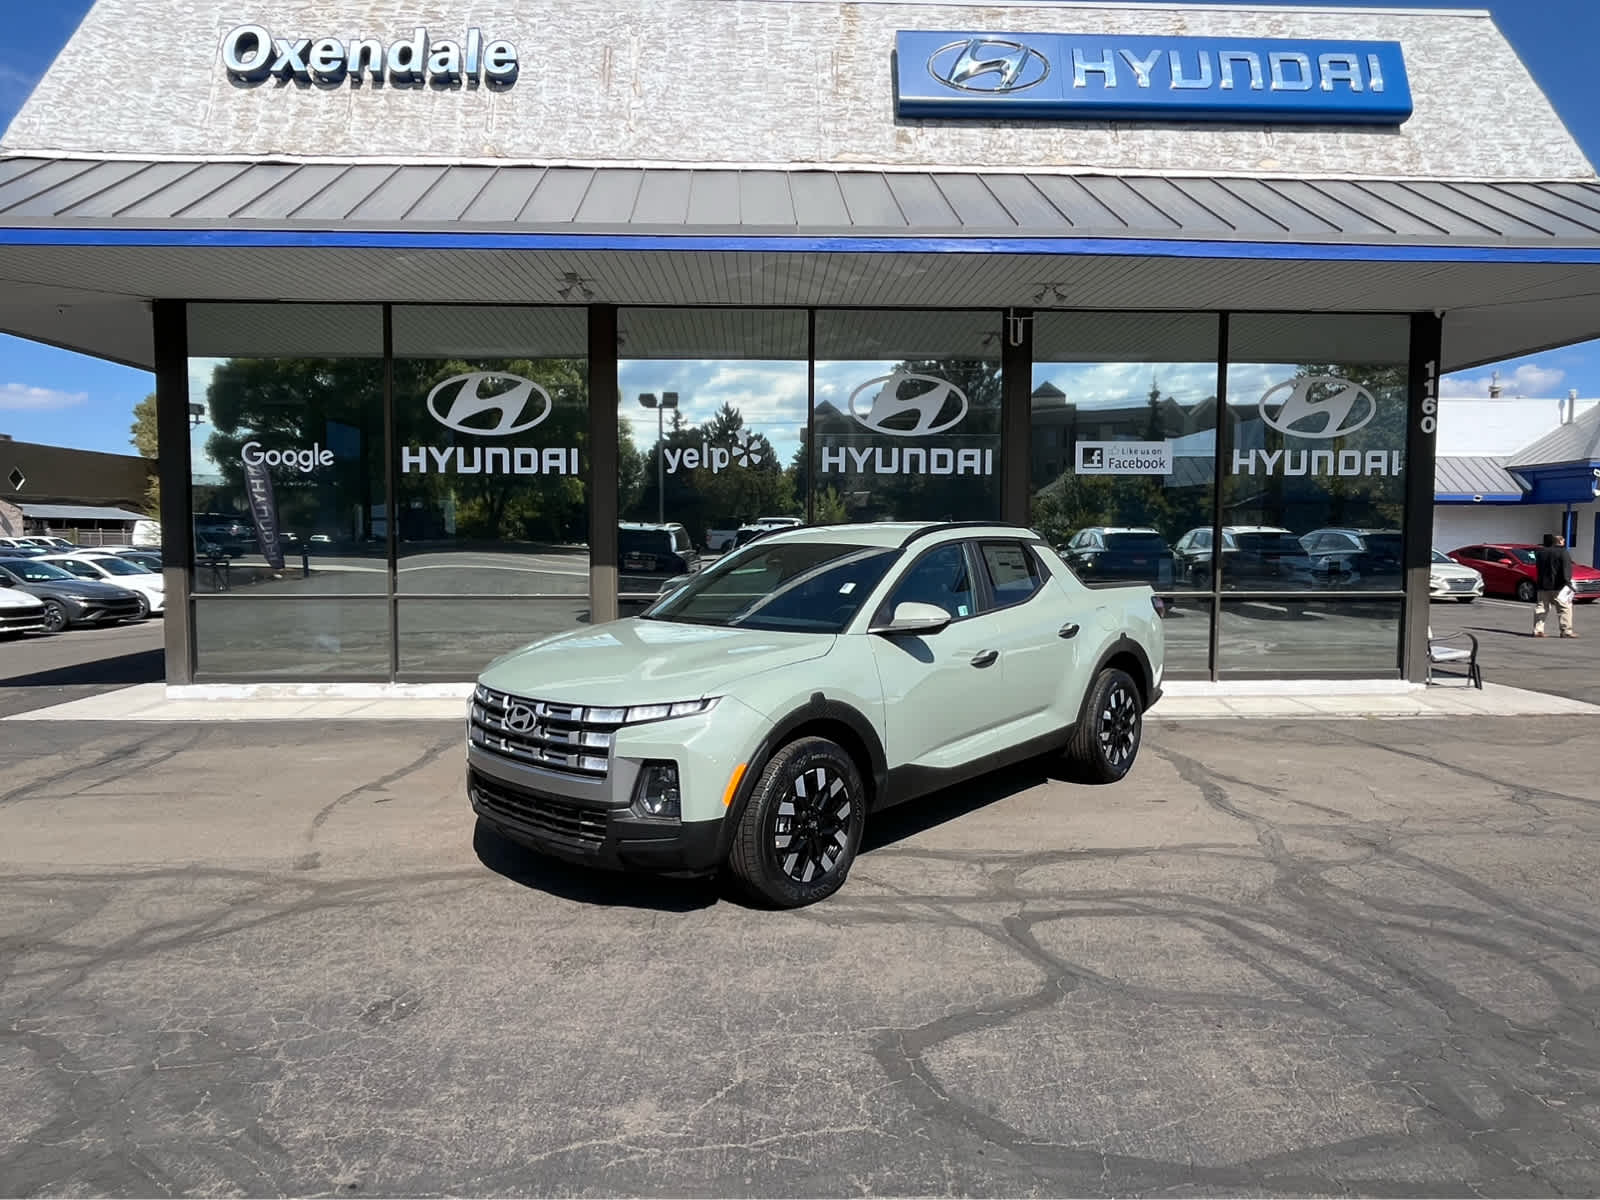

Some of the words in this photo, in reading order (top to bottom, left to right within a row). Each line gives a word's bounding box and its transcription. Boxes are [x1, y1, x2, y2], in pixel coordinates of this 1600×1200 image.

[221, 24, 519, 89] Oxendale
[1072, 47, 1384, 92] HYUNDAI
[1420, 360, 1437, 434] 1160
[241, 441, 335, 473] Google
[402, 446, 579, 475] HYUNDAI
[663, 442, 730, 474] yelp
[821, 446, 993, 475] HYUNDAI
[1108, 456, 1166, 469] Facebook
[1121, 447, 1138, 455] Like
[1231, 449, 1402, 476] HYUNDAI
